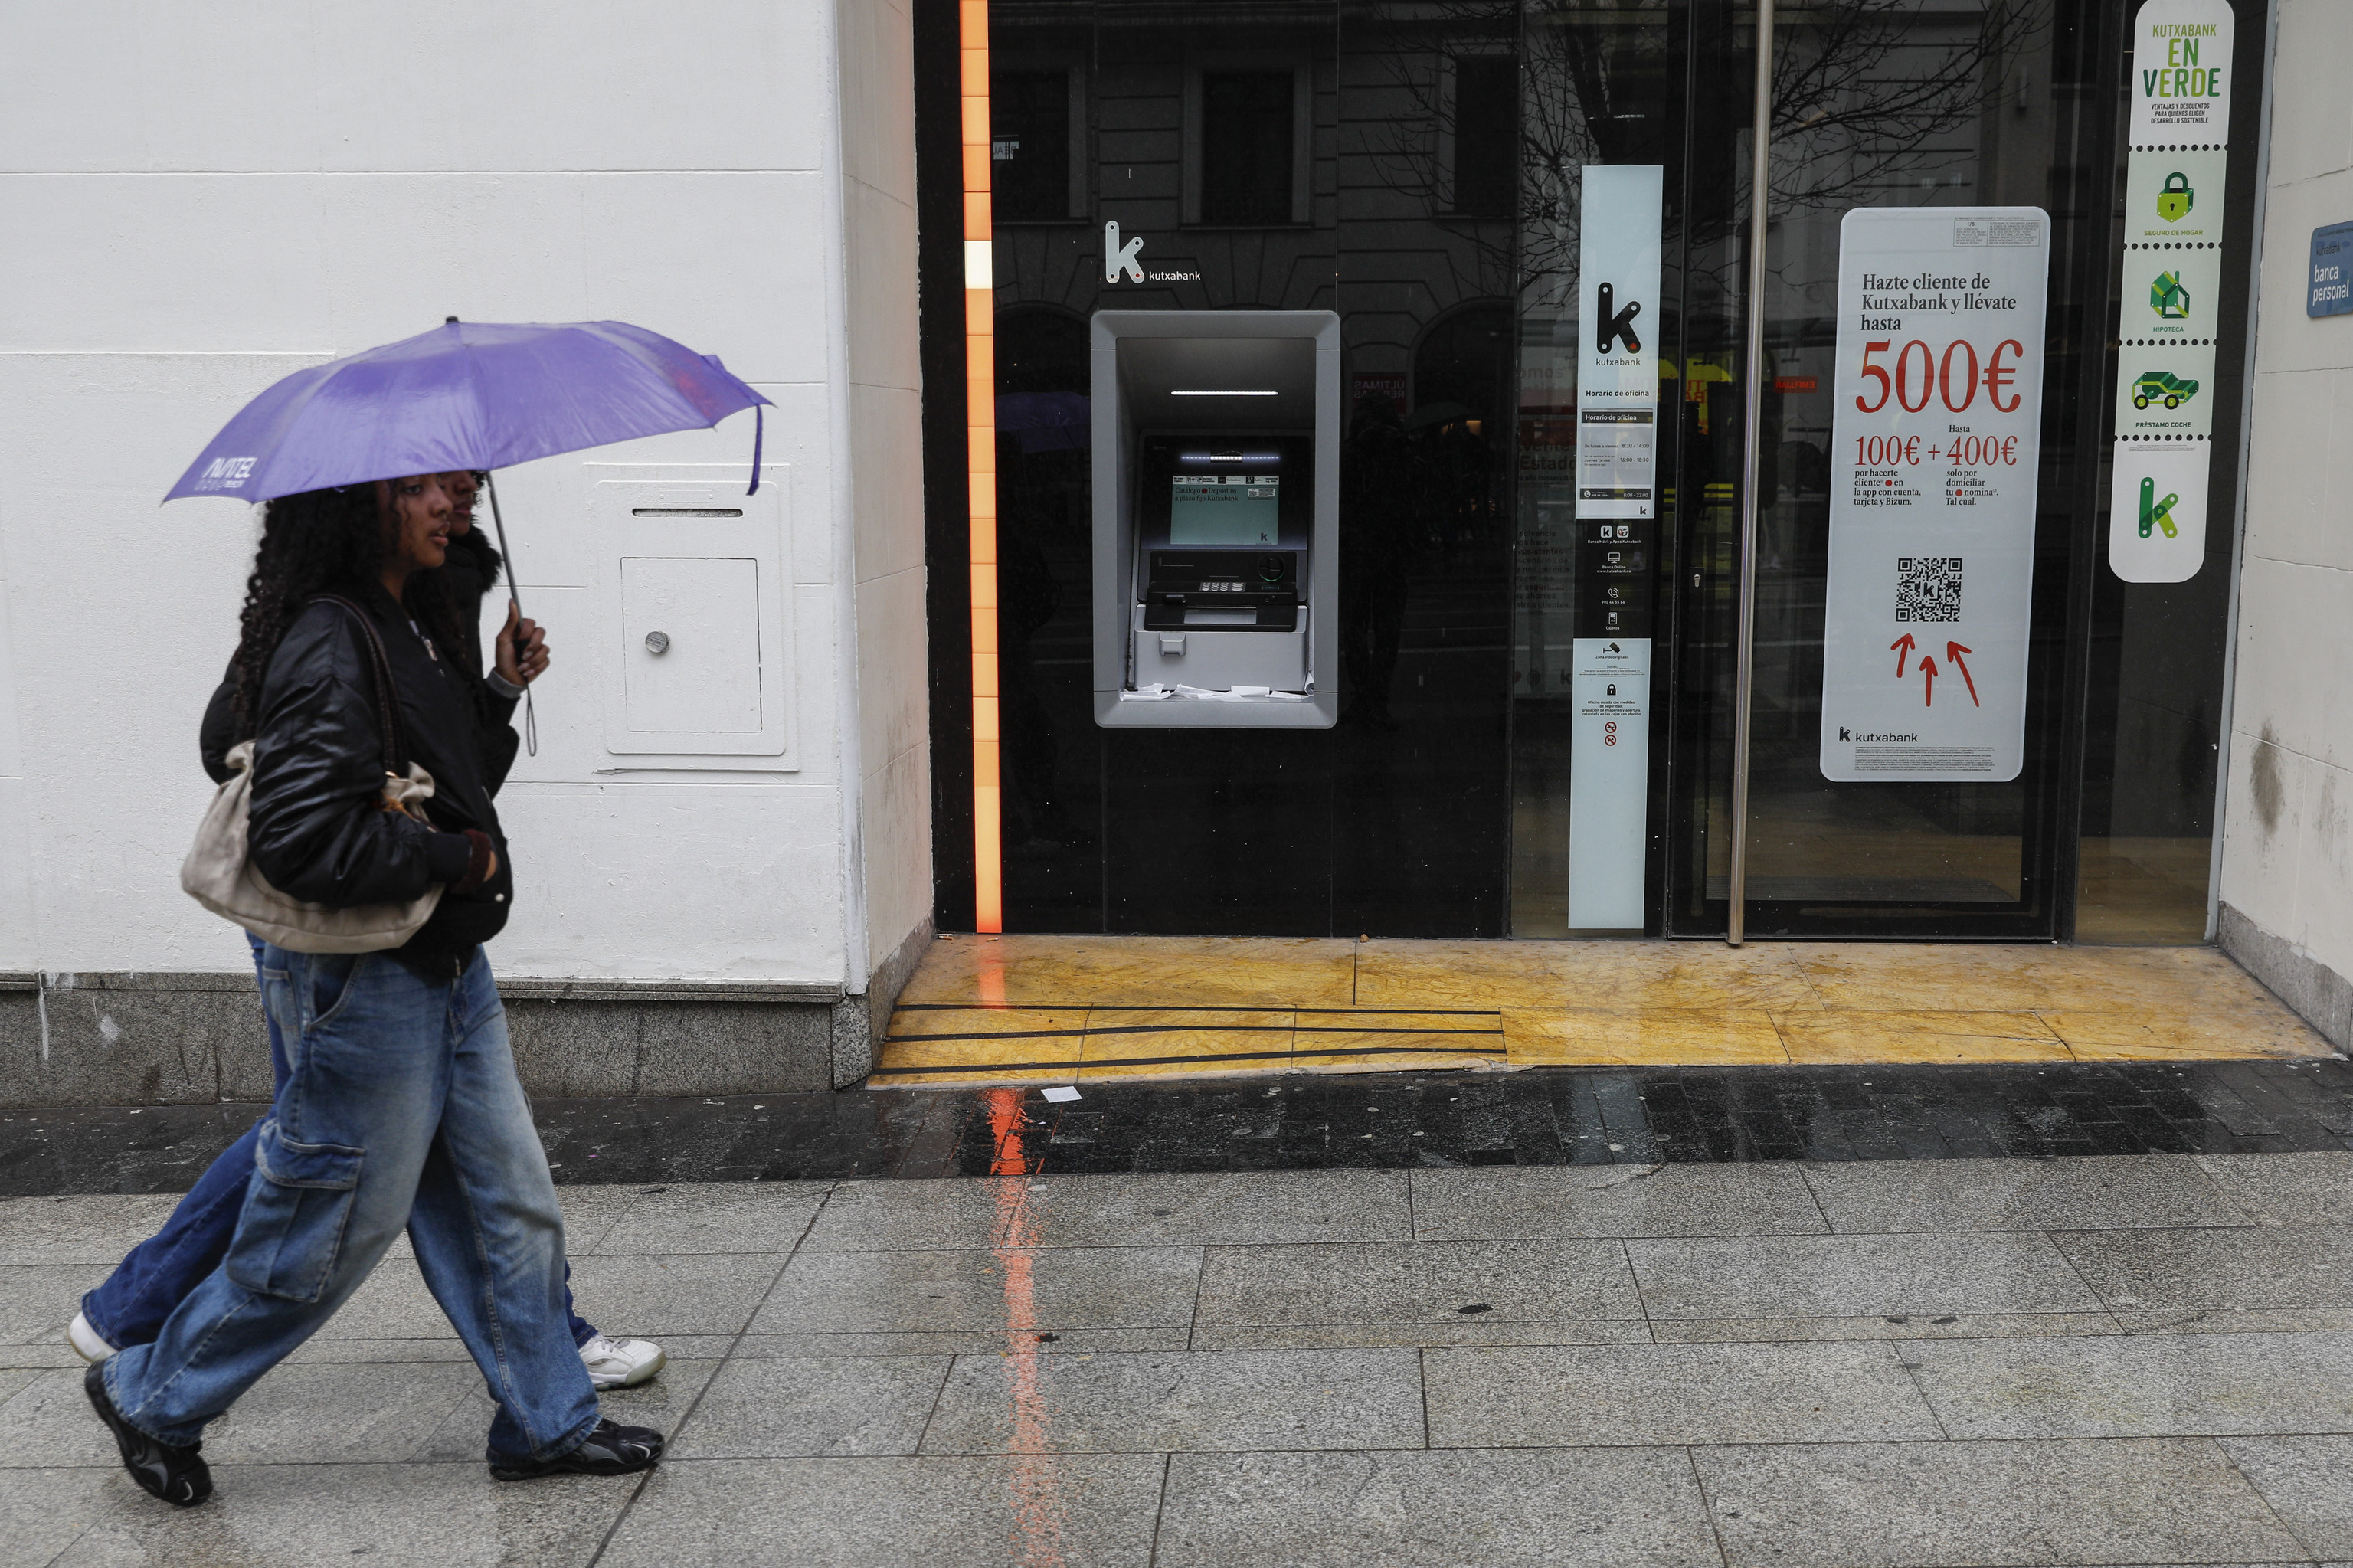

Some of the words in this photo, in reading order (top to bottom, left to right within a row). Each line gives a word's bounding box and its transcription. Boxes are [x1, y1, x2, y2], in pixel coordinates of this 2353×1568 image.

[2152, 24, 2217, 37] KUTXABANK
[2168, 38, 2199, 67] EN
[2143, 68, 2221, 98] VERDE
[1149, 271, 1201, 280] kutxabank
[1862, 273, 1909, 290] Hazte
[1913, 273, 1967, 290] cliente
[1972, 272, 1990, 289] de
[2314, 264, 2339, 282] banca
[2313, 279, 2349, 306] personal
[1862, 294, 1949, 310] Kutxabank
[1951, 298, 1961, 313] y
[1964, 292, 2016, 310] llévate
[1861, 314, 1901, 331] hasta
[1595, 358, 1641, 366] kutxabank
[1856, 339, 2023, 413] 500€
[1949, 424, 1970, 433] Hasta
[1855, 435, 1921, 466] 100€
[1928, 444, 1940, 460] +
[1946, 435, 2018, 466] 400€
[1947, 468, 1962, 476] solo
[1964, 470, 1977, 480] por
[1854, 498, 1878, 507] tarjeta
[1856, 733, 1918, 742] kutxabank
